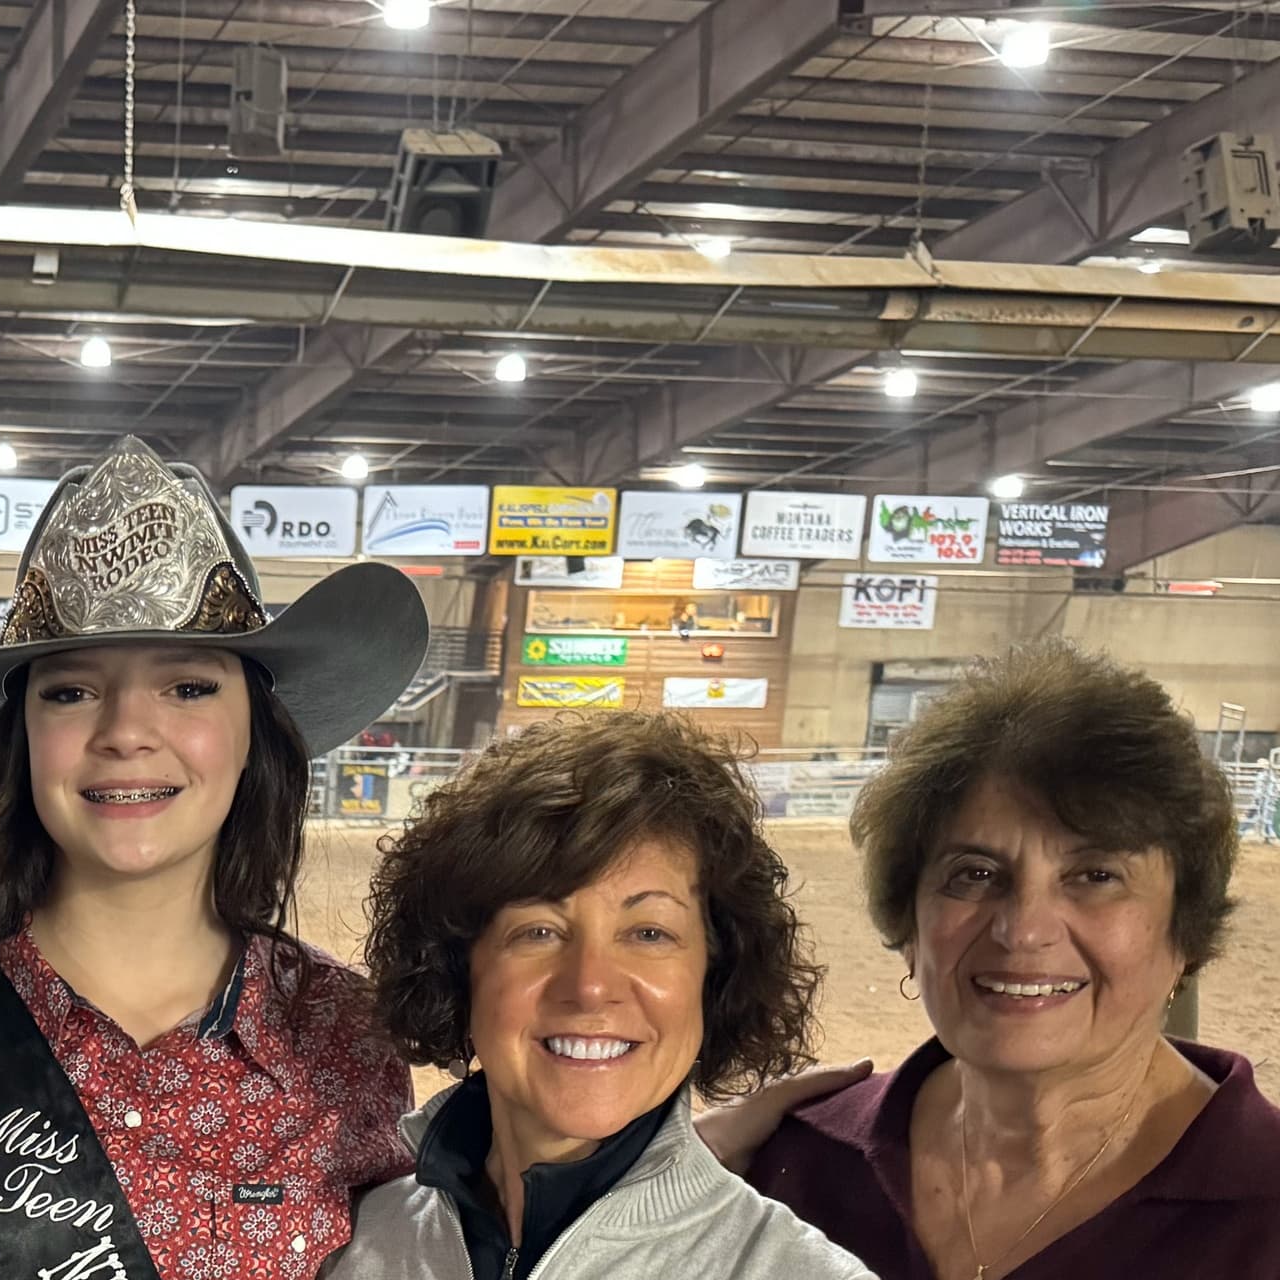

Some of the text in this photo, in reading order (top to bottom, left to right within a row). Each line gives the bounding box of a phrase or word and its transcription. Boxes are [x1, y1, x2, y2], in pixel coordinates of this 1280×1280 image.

[777, 511, 832, 526] MONTANA
[1000, 503, 1109, 522] VERTICAL IRON
[72, 502, 177, 554] MISS TEEN
[281, 520, 331, 538] RDO
[750, 525, 855, 543] COFFEE TRADERS
[998, 519, 1053, 537] WORKS
[74, 522, 179, 574] NWMT
[88, 541, 170, 592] RODEO
[853, 577, 926, 603] KOFI
[237, 1186, 278, 1201] Wrangler
